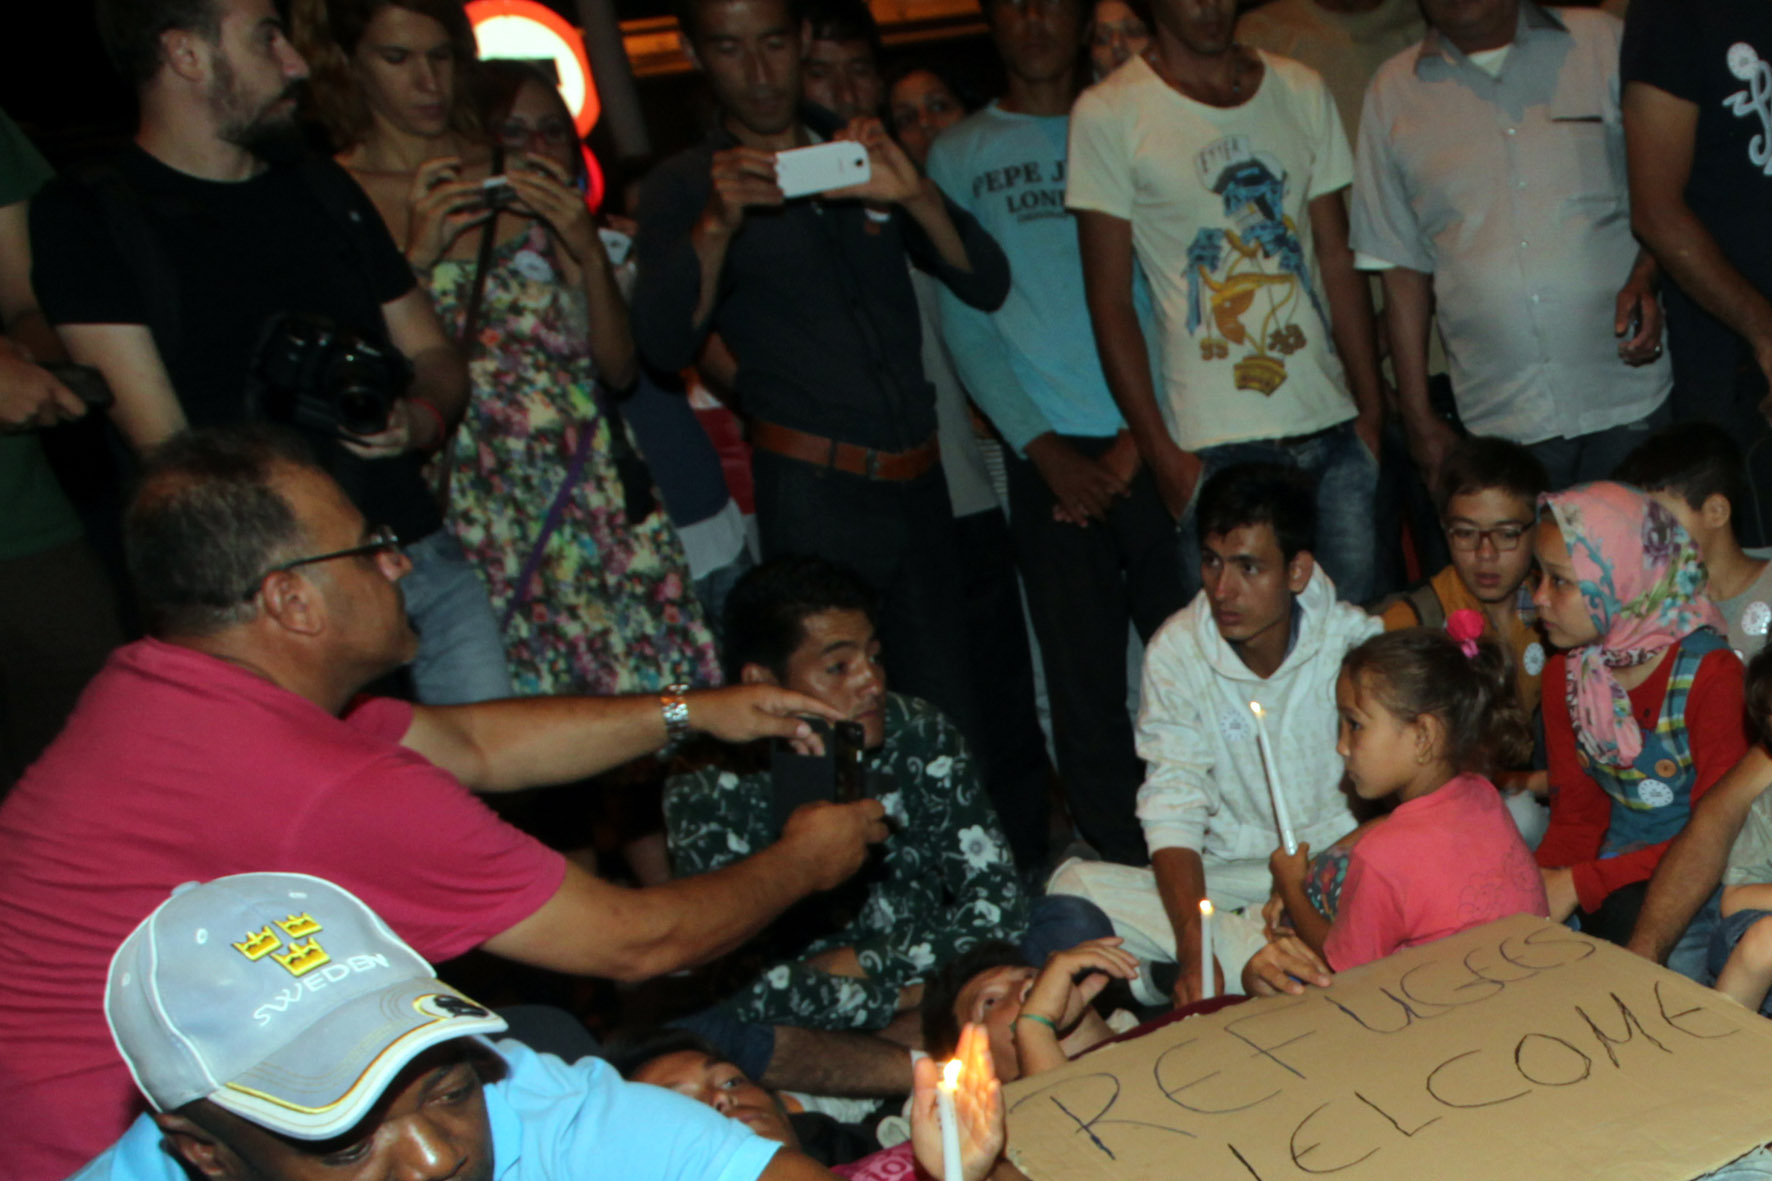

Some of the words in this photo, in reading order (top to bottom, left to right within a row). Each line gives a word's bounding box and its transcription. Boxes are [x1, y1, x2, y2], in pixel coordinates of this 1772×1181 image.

[972, 162, 1043, 198] PEPE
[253, 953, 390, 1027] SWEDEN
[1009, 926, 1597, 1160] REFUGEES
